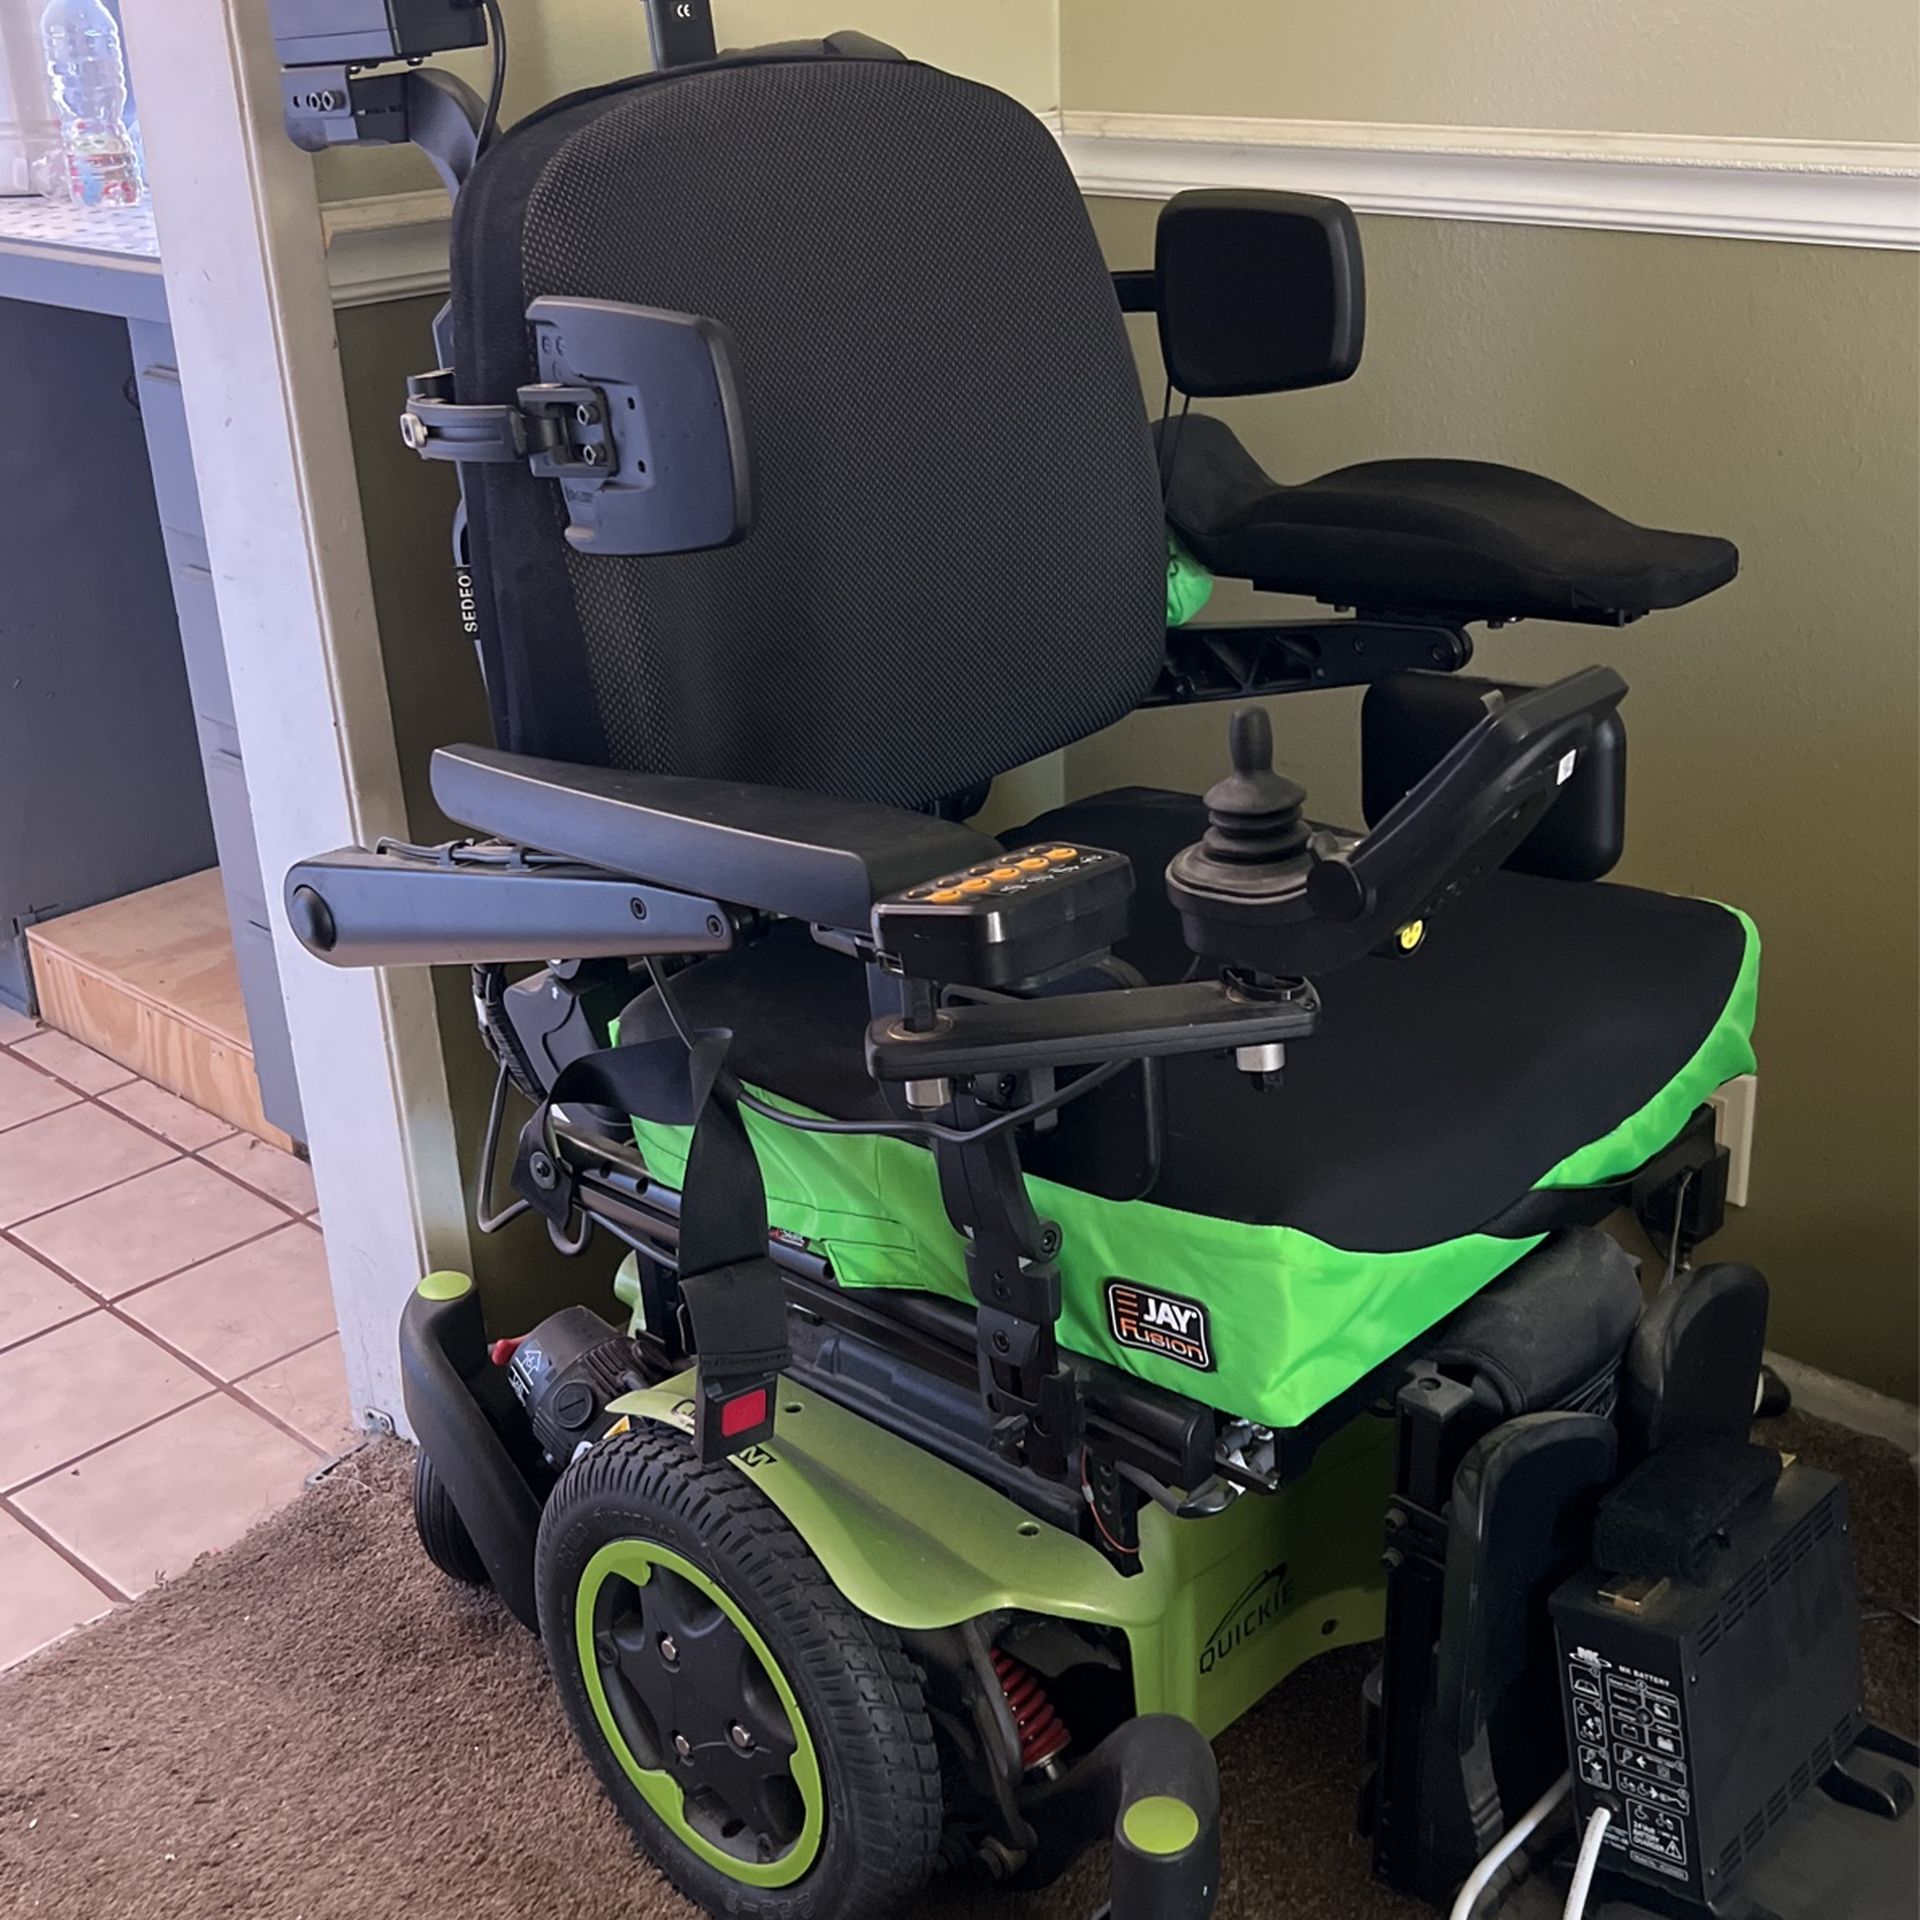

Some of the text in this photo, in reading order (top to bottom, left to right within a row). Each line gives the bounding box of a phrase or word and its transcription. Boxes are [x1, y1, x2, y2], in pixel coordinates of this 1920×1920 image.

[457, 575, 478, 632] SEDEO
[1143, 1298, 1190, 1334] JAY
[1200, 1582, 1294, 1674] QUICKIE
[1633, 1669, 1670, 1687] BATTERY
